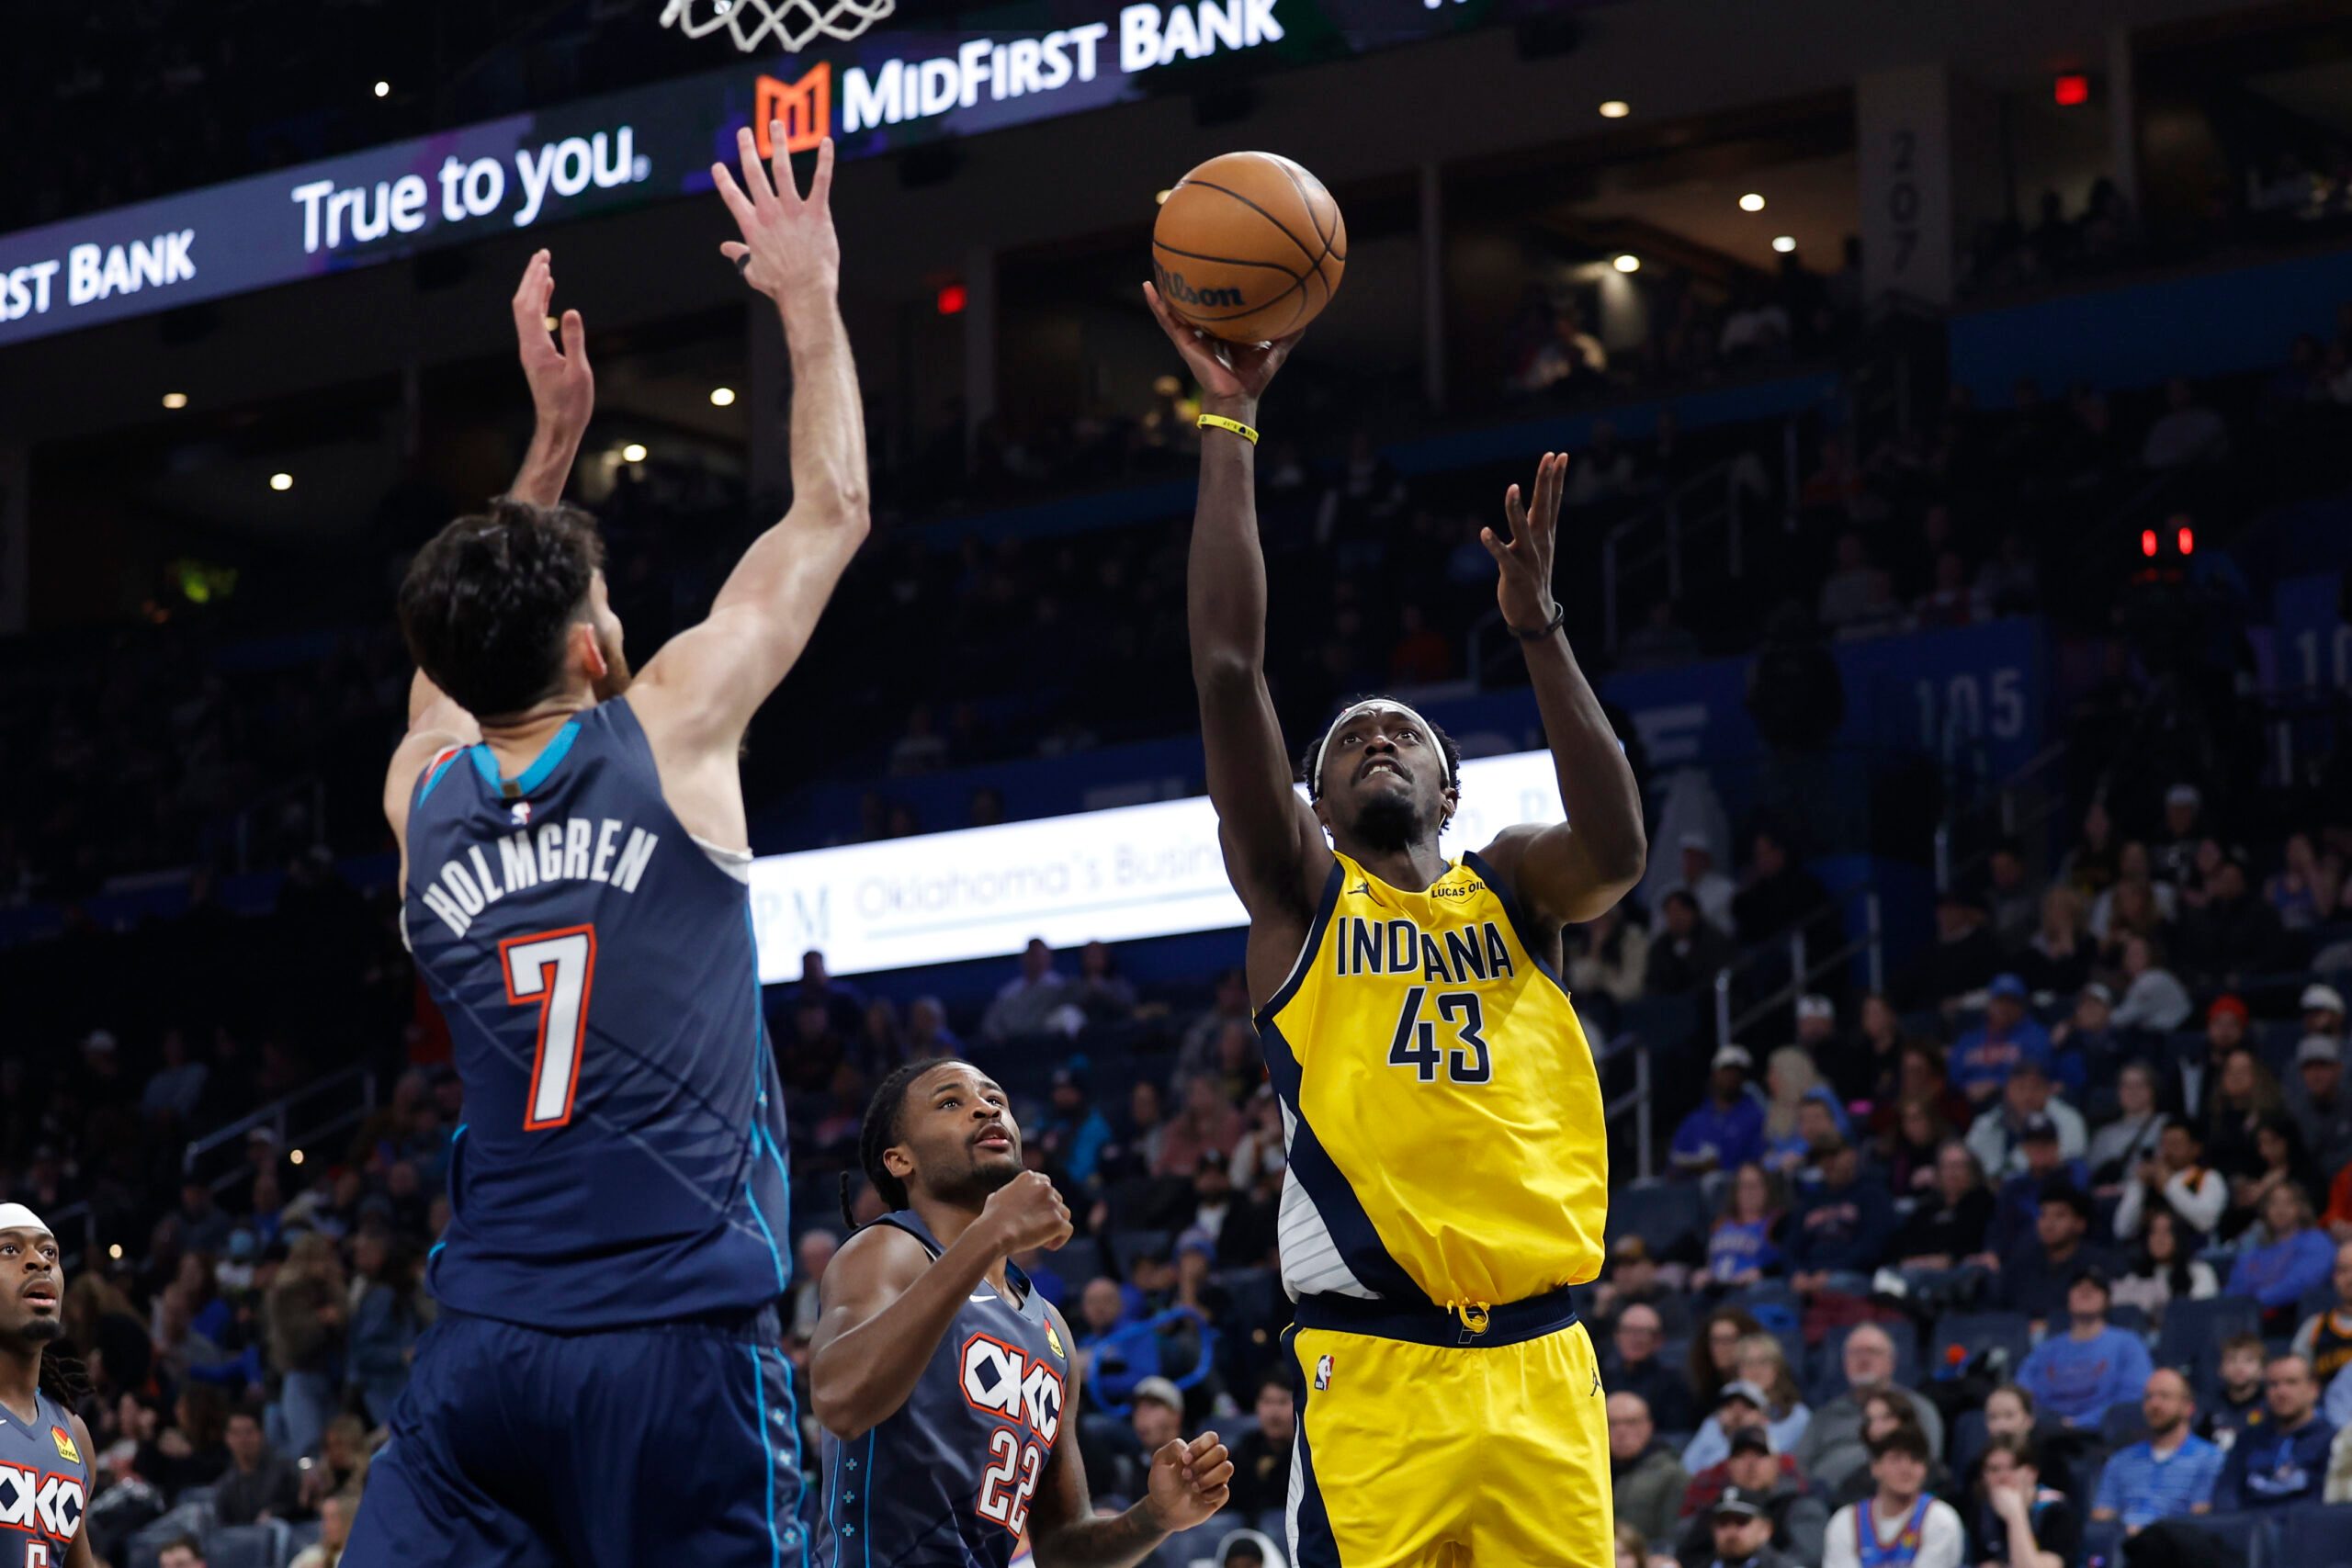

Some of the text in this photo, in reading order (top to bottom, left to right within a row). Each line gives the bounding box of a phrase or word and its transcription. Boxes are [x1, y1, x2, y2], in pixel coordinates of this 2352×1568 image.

[1119, 0, 1285, 73] BANK
[290, 179, 428, 254] True
[437, 154, 505, 222] to
[68, 228, 197, 307] BANK
[422, 817, 659, 940] HOLMGREN
[1430, 881, 1486, 898] LUCAS OIL
[498, 922, 597, 1133] 7
[1387, 986, 1494, 1086] 43
[959, 1331, 1066, 1450] OKC
[975, 1426, 1042, 1540] 22
